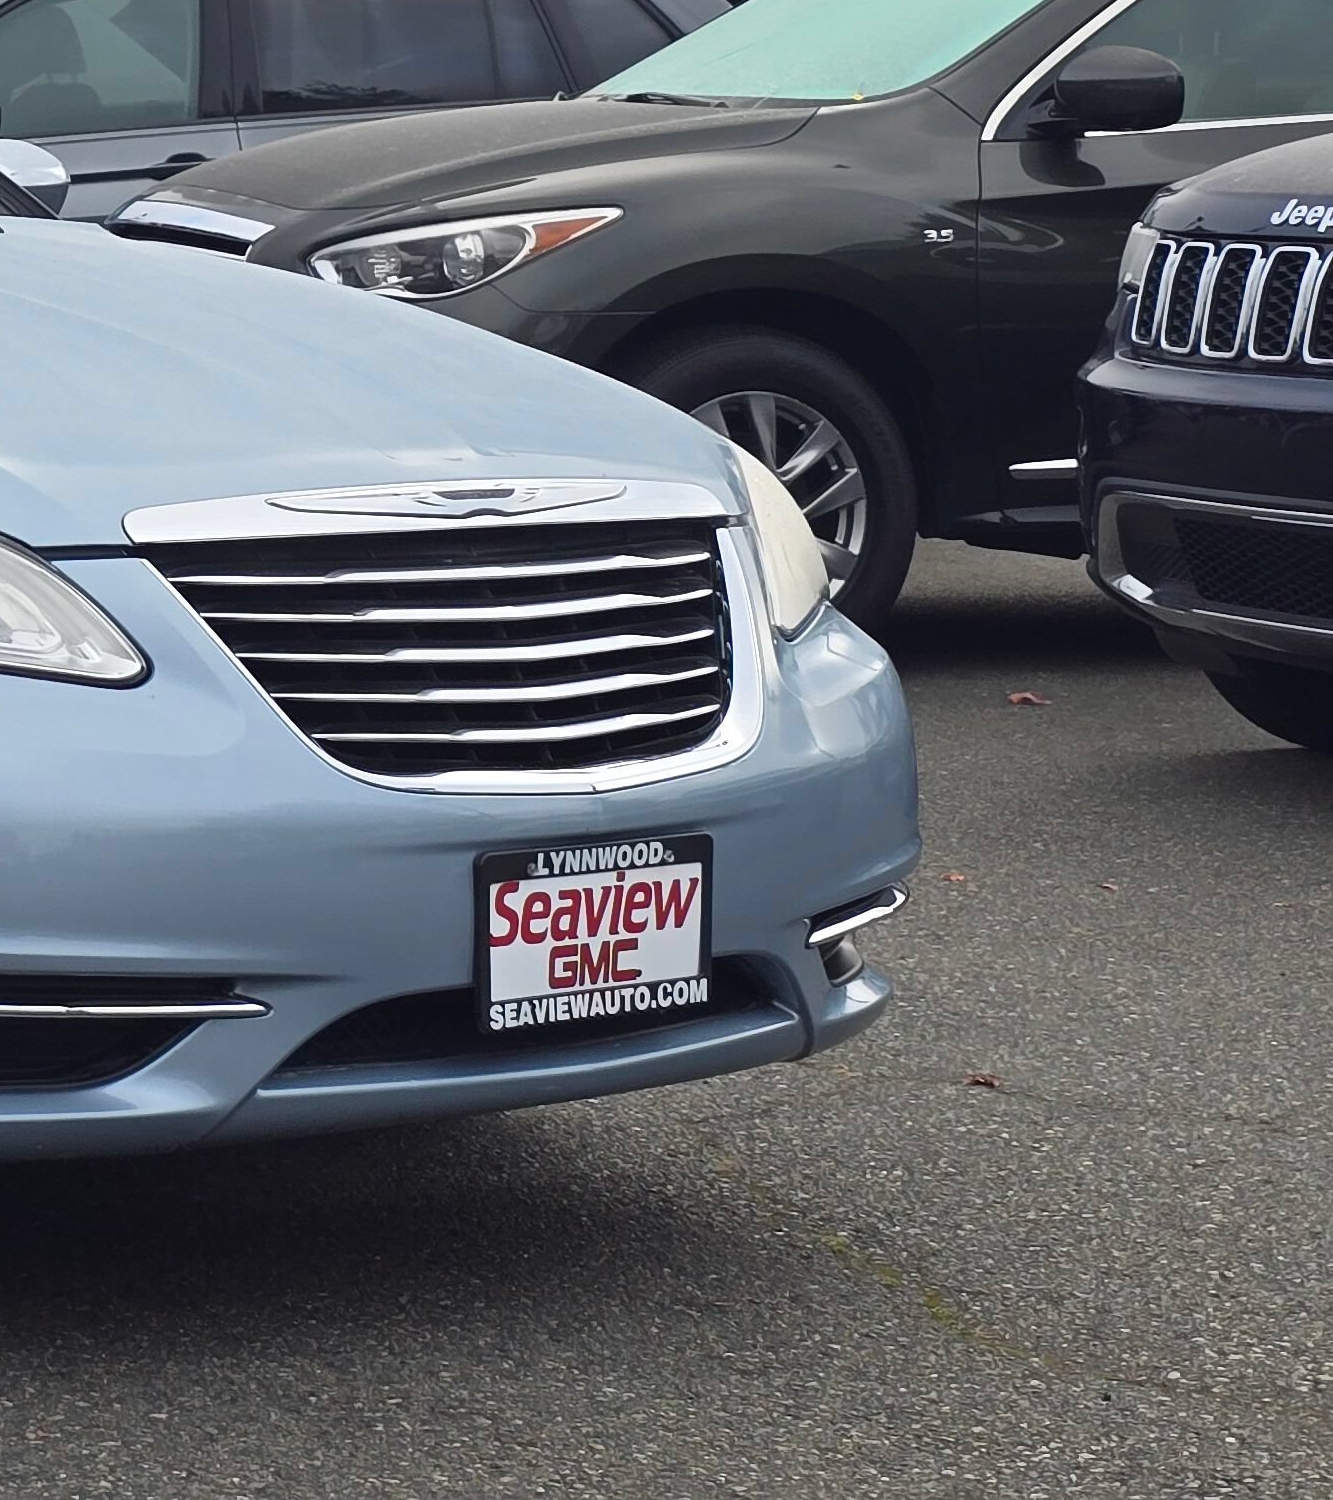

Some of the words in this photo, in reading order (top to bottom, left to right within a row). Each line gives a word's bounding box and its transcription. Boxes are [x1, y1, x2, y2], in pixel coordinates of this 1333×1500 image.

[536, 841, 664, 876] LYNNWOOD
[489, 871, 700, 947] Seaview
[548, 938, 642, 989] GMC
[489, 978, 708, 1030] SEAVIEWAUTO.COM
